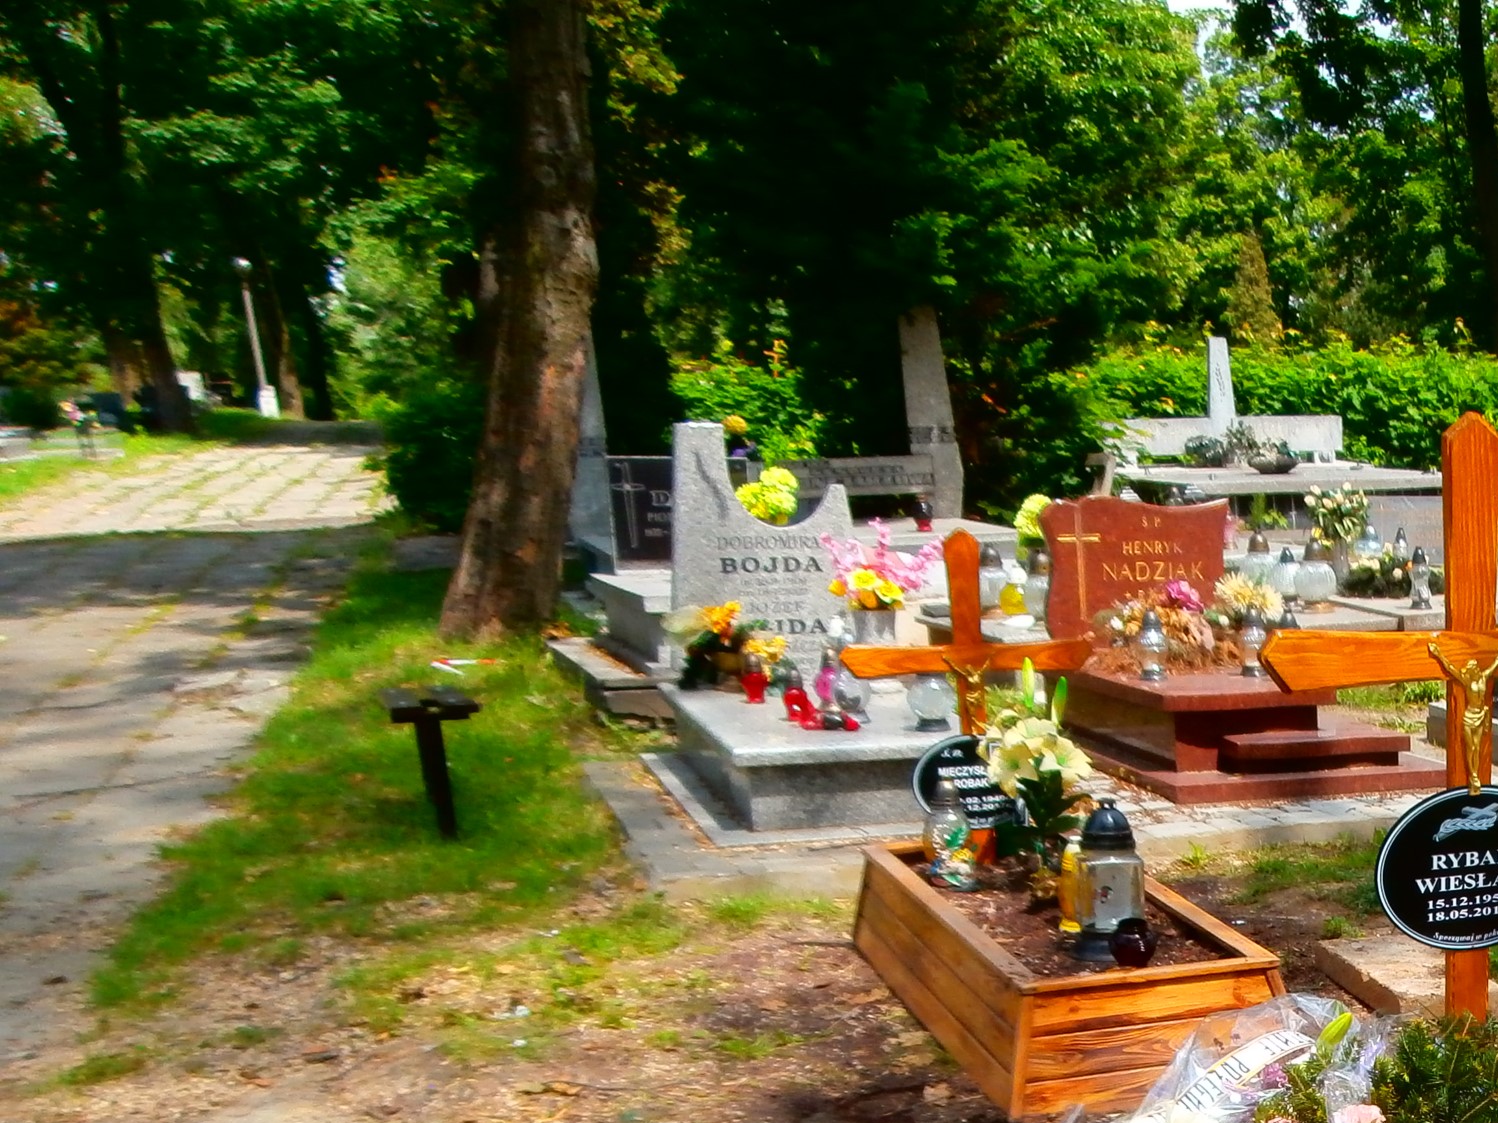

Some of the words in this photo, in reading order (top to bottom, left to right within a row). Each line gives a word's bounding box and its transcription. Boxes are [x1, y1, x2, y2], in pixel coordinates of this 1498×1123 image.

[1122, 540, 1183, 555] HENRYK
[719, 556, 824, 574] BOJDA
[1101, 560, 1205, 582] NADZIAK
[953, 777, 991, 790] ROBAK
